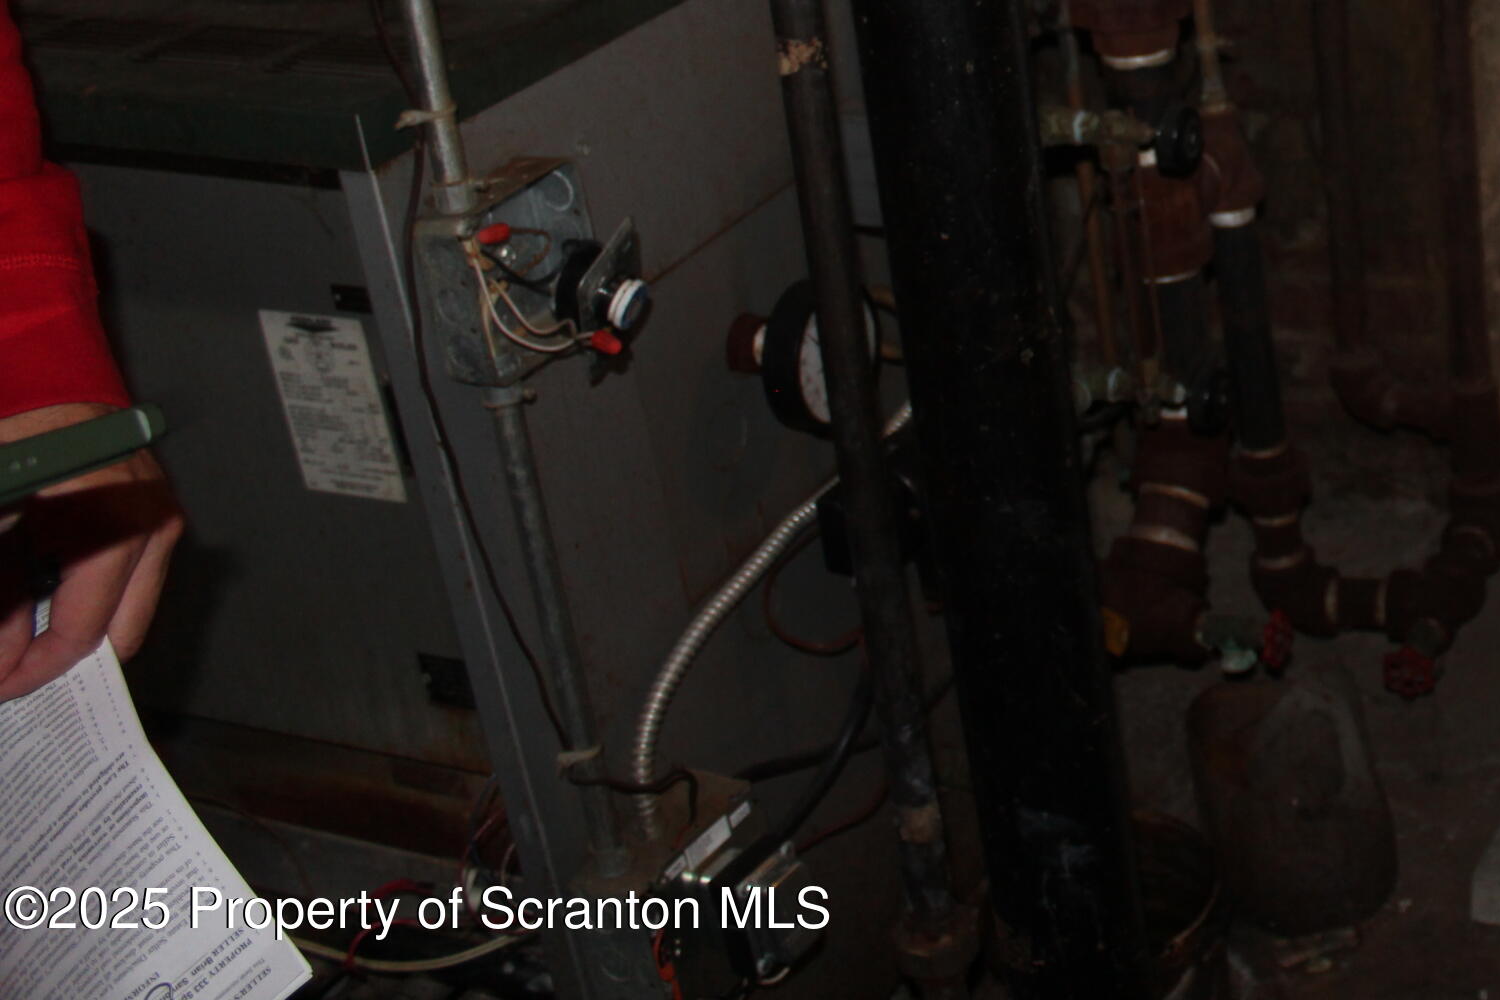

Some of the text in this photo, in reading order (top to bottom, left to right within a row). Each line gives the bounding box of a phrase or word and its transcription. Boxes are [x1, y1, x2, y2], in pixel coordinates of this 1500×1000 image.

[189, 926, 245, 977] SELLER Brian
[206, 937, 254, 977] PROPERTY
